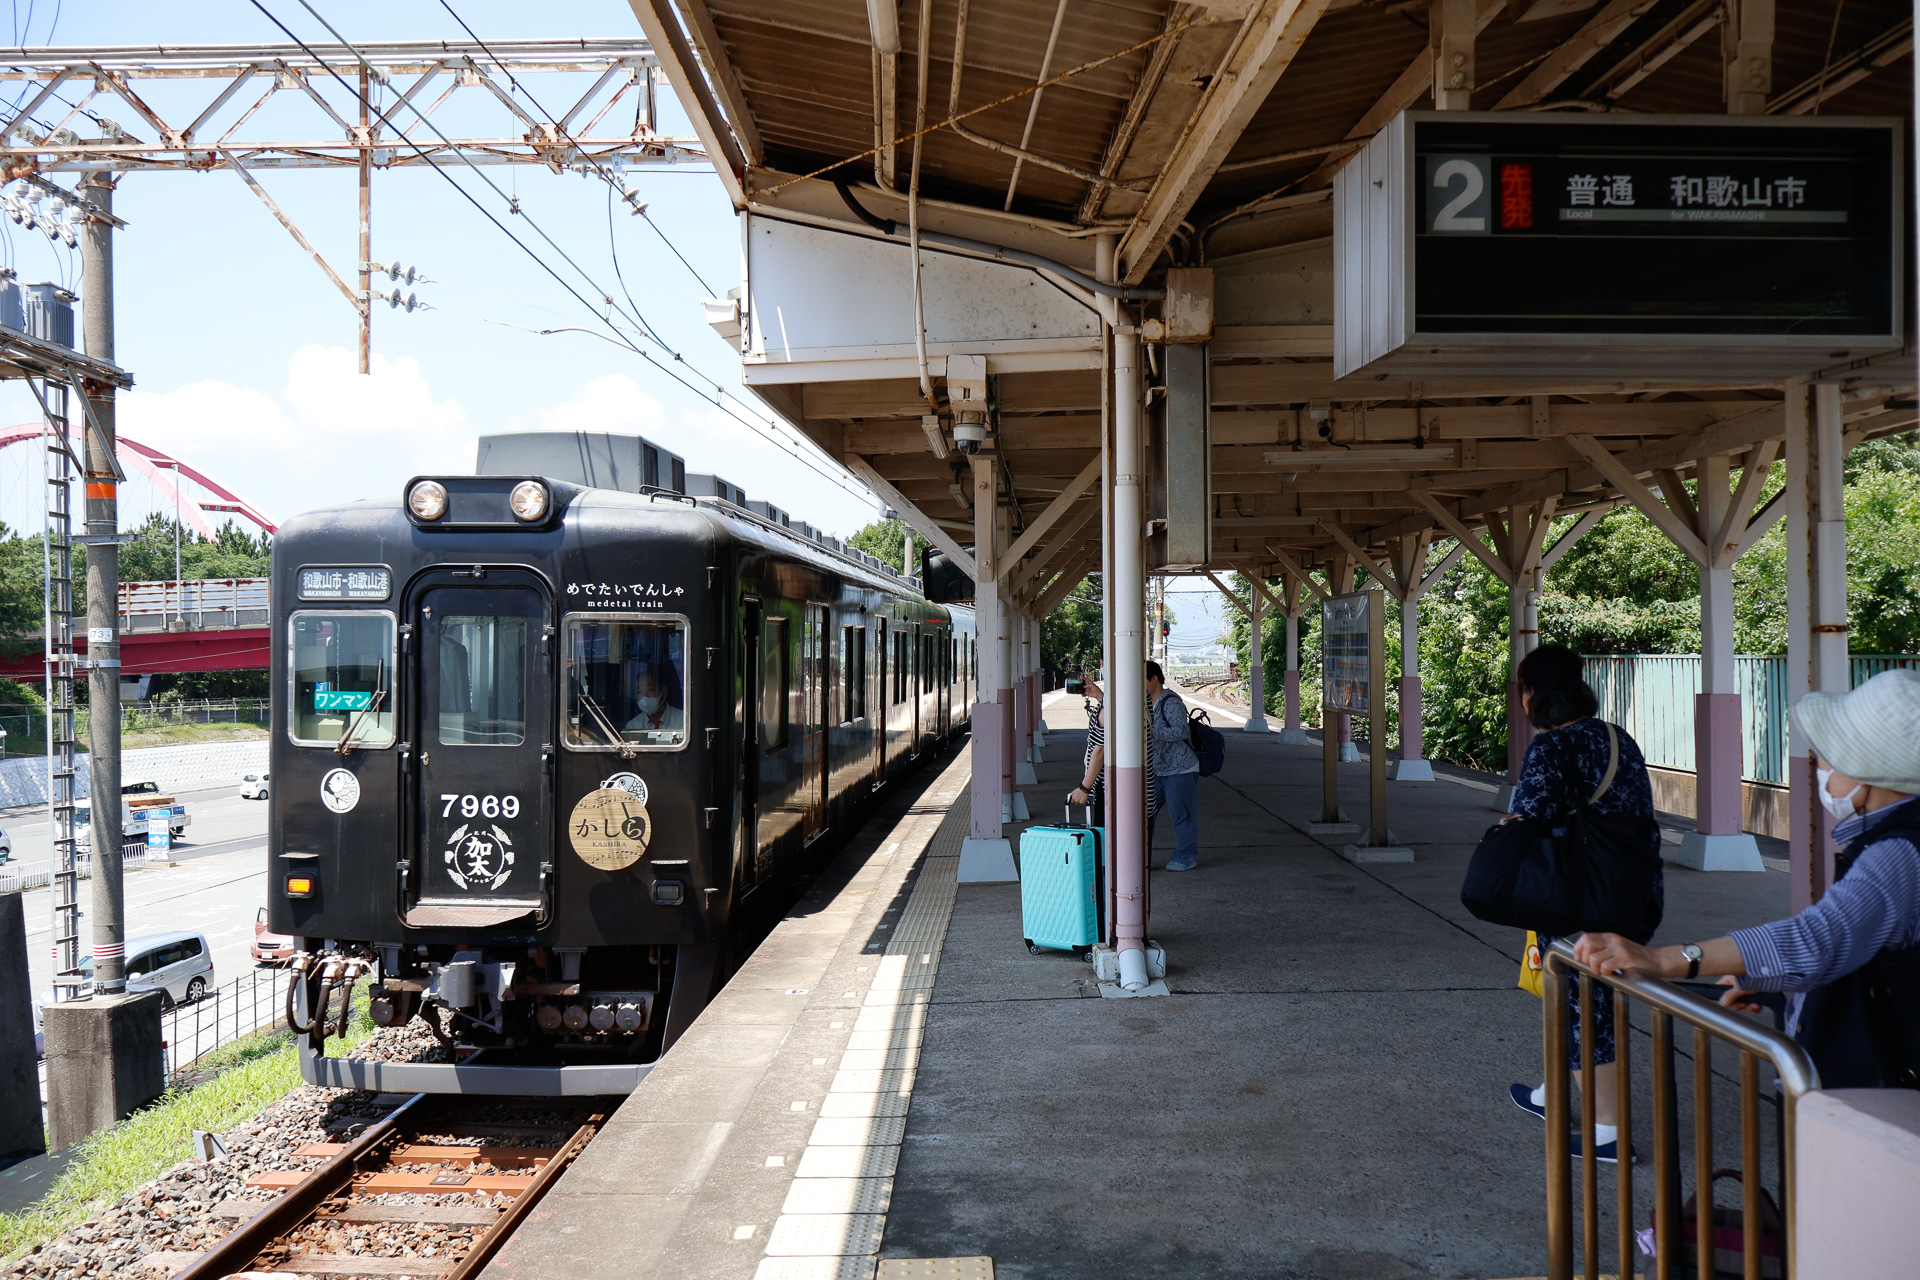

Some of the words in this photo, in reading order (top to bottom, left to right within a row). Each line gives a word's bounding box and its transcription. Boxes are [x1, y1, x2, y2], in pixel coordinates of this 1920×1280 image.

[1433, 159, 1485, 231] 2
[1502, 164, 1532, 228] 先発
[1566, 174, 1636, 206] 普通
[1670, 175, 1808, 208] 和歌山市
[1566, 209, 1594, 219] Local
[1670, 210, 1685, 220] for
[1688, 210, 1765, 221] WAKAYAMASHI
[566, 582, 685, 597] めでたいでんしゃ
[636, 600, 664, 608] train
[315, 693, 370, 708] ワンマン
[440, 794, 520, 819] 7969
[575, 818, 642, 839] かしら
[464, 836, 494, 877] 加太
